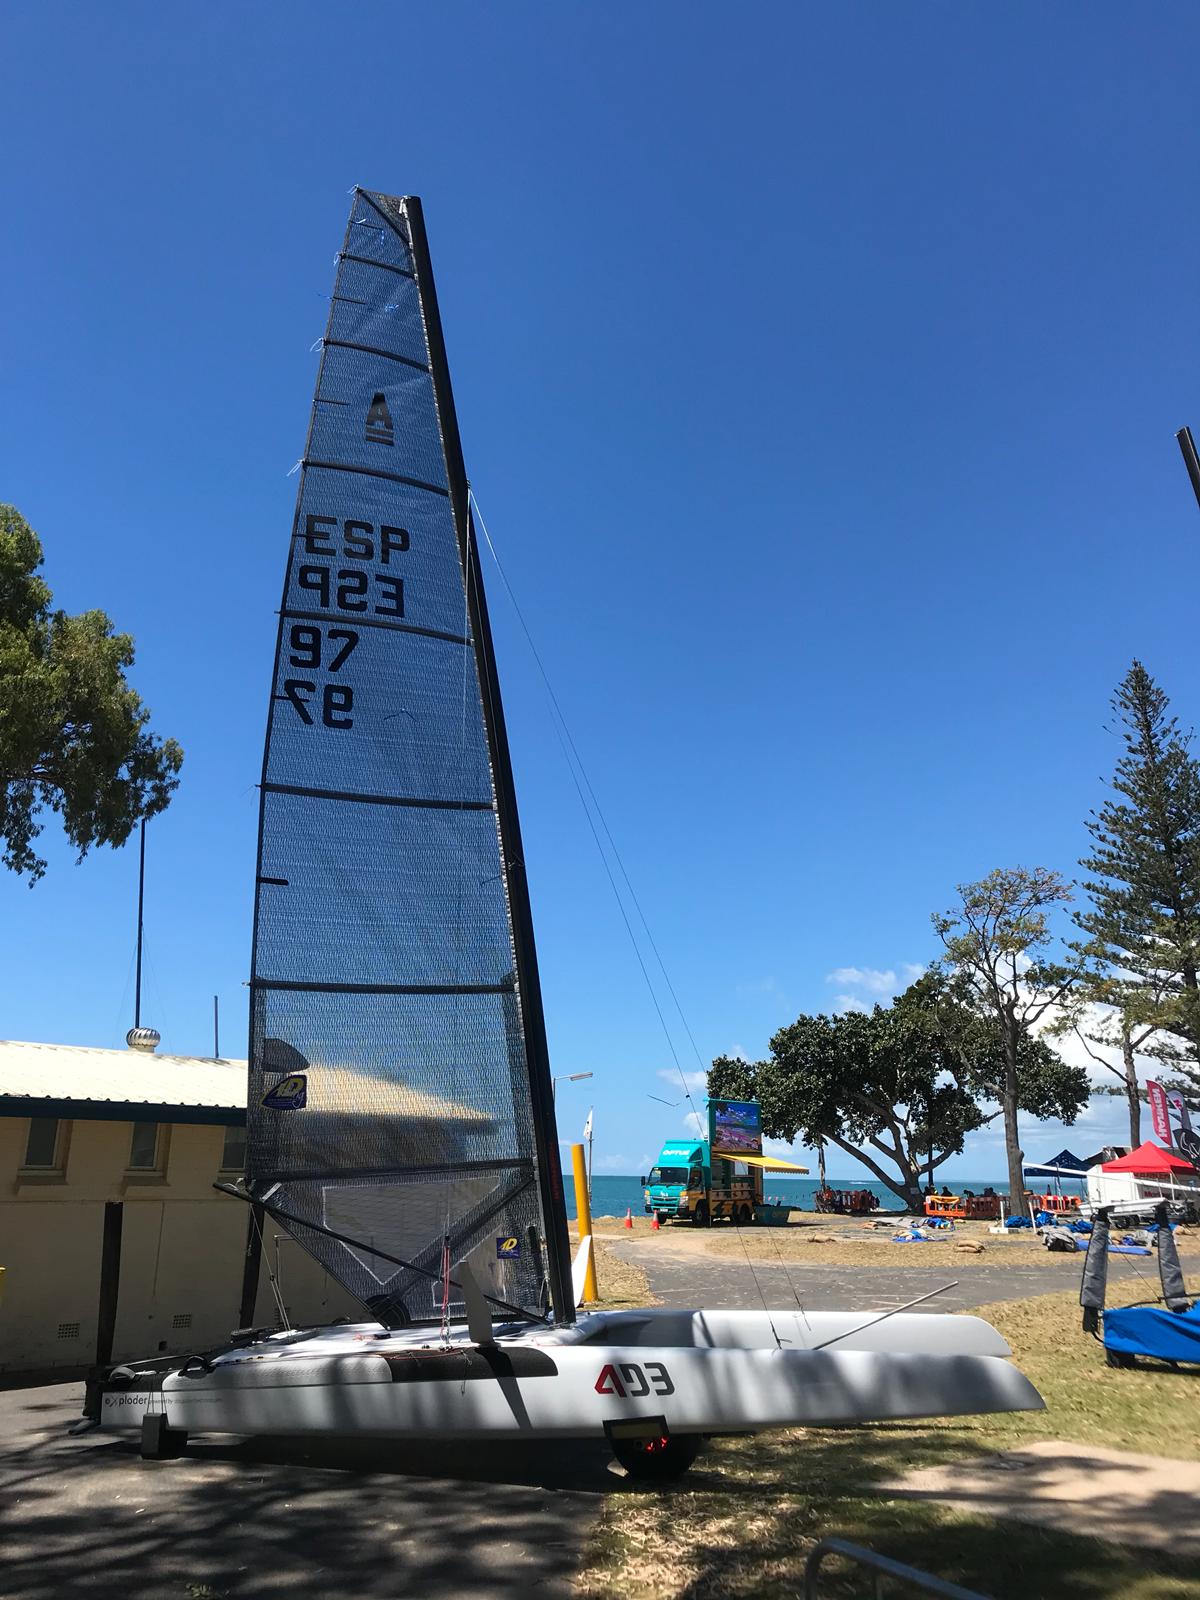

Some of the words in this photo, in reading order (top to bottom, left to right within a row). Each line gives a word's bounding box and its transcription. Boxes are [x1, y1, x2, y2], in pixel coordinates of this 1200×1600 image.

[305, 514, 410, 564] ESP
[289, 625, 359, 672] 97
[594, 1362, 675, 1398] AD3
